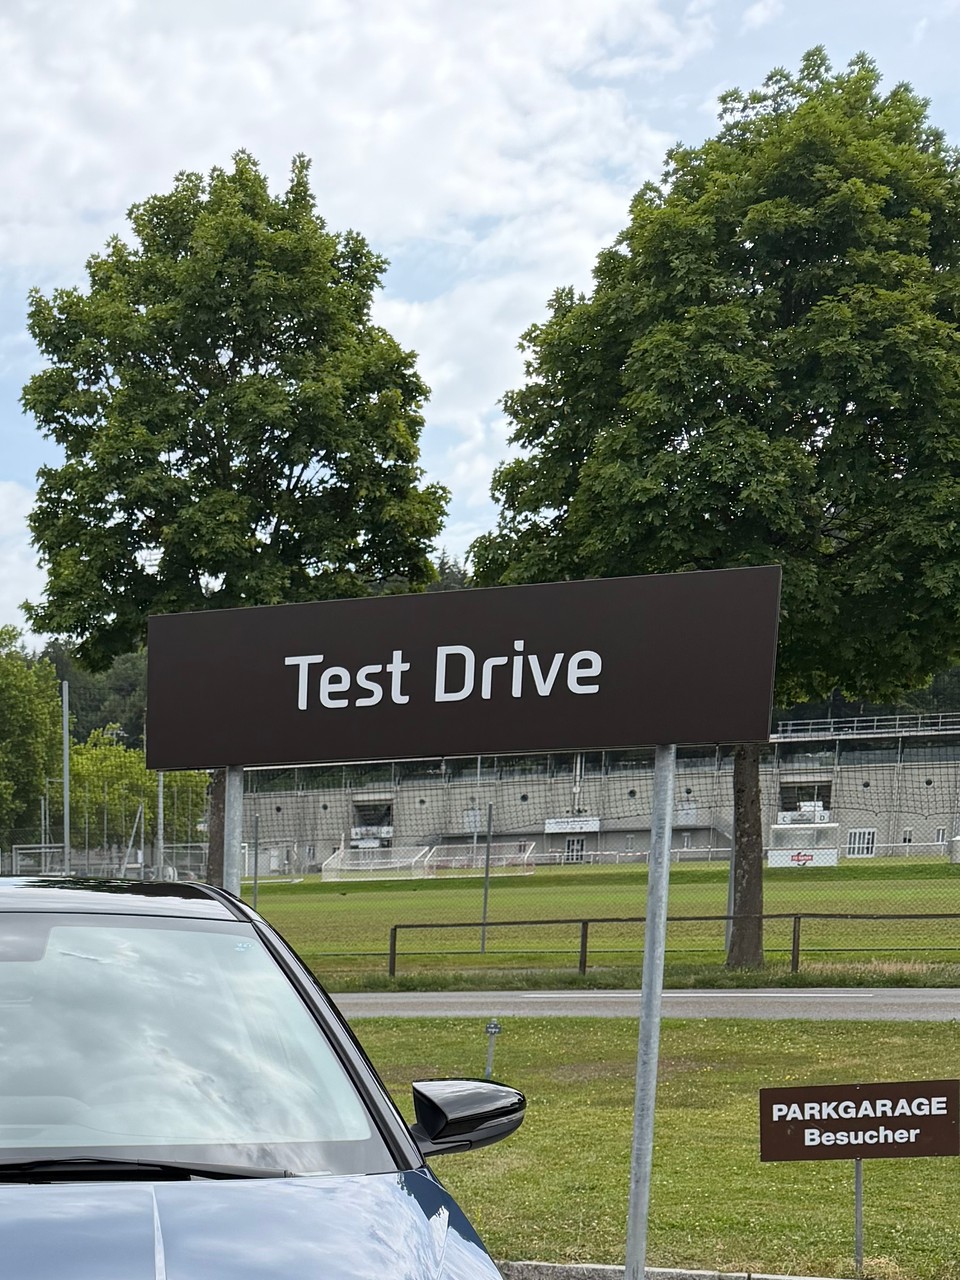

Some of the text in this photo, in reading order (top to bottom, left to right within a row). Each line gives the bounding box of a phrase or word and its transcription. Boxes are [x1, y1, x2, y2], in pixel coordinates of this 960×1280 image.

[284, 639, 603, 711] Test Drive
[772, 1097, 948, 1121] PARKGARAGE
[804, 1126, 920, 1146] Besucher
